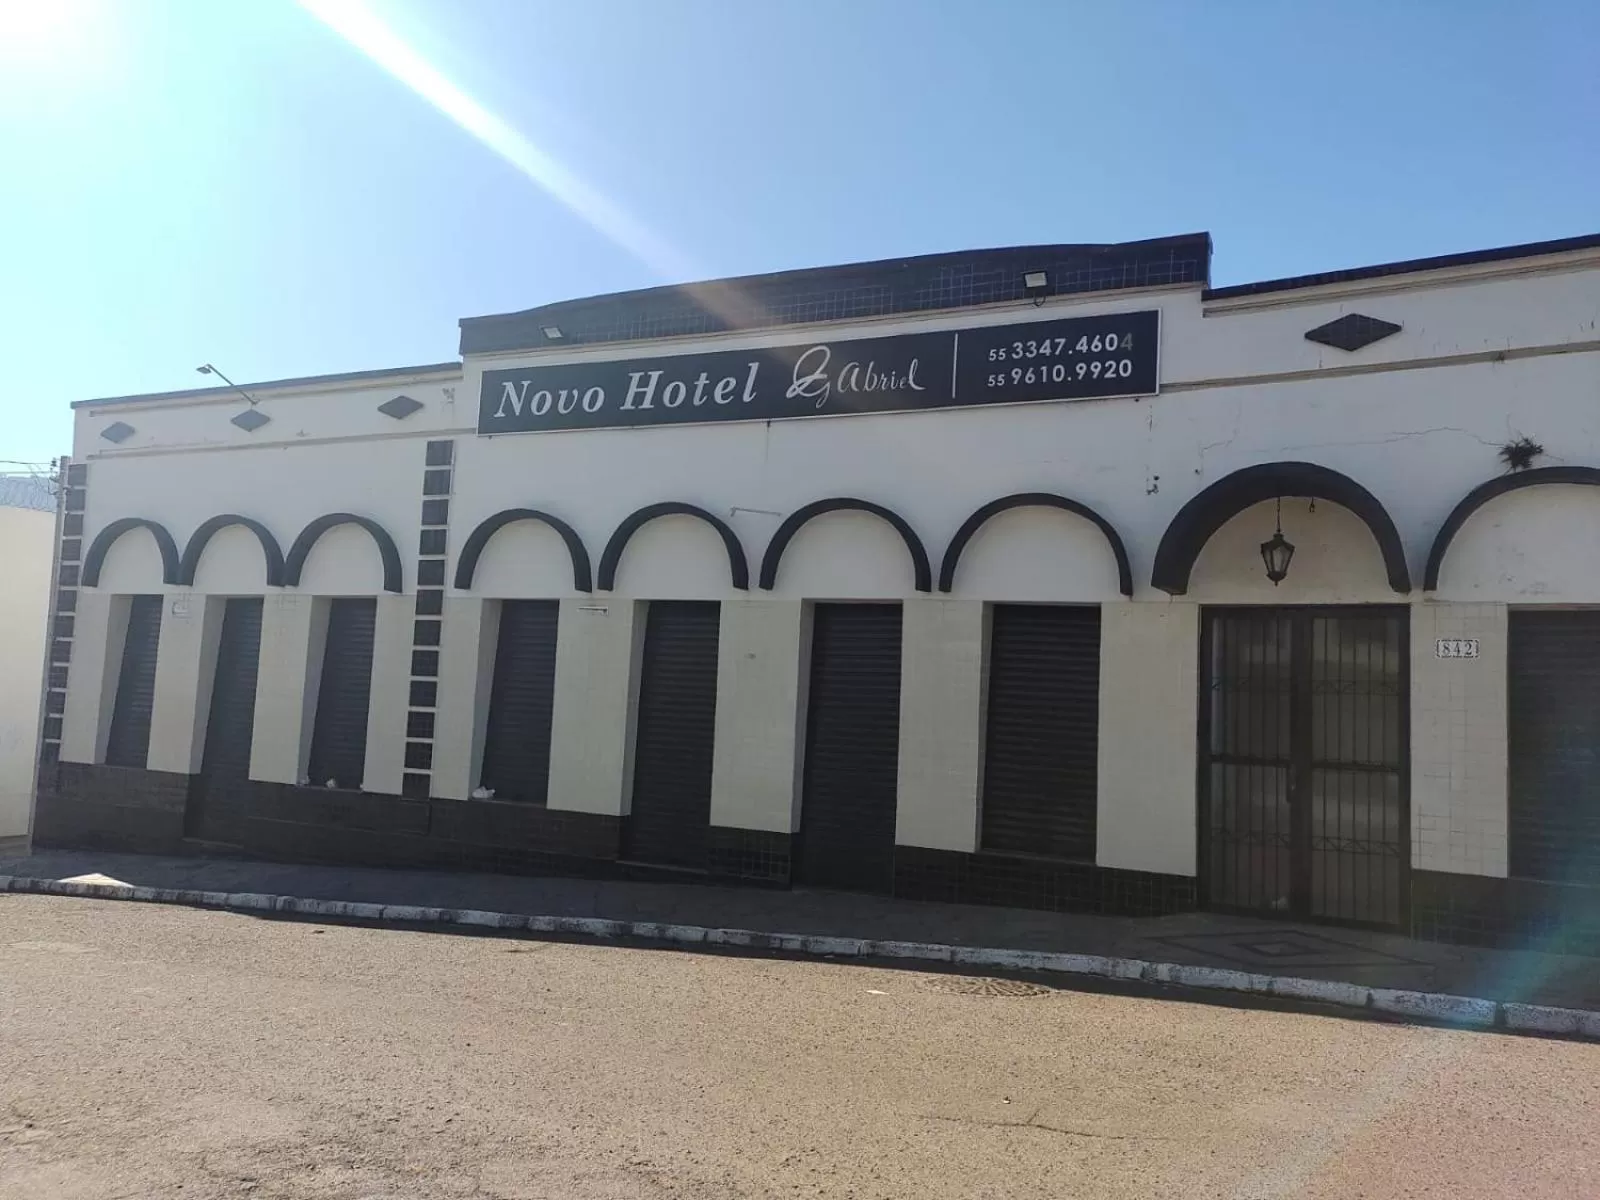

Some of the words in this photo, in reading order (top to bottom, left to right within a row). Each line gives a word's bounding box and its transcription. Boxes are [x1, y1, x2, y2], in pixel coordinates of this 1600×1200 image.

[988, 348, 1006, 361] 55
[1011, 332, 1134, 359] 3347.4604
[494, 380, 605, 417] Novo
[620, 361, 759, 411] Hotel
[785, 345, 926, 408] Gabriel
[987, 373, 1005, 387] 55
[1011, 359, 1132, 386] 9610.9920
[1443, 642, 1472, 655] 842
